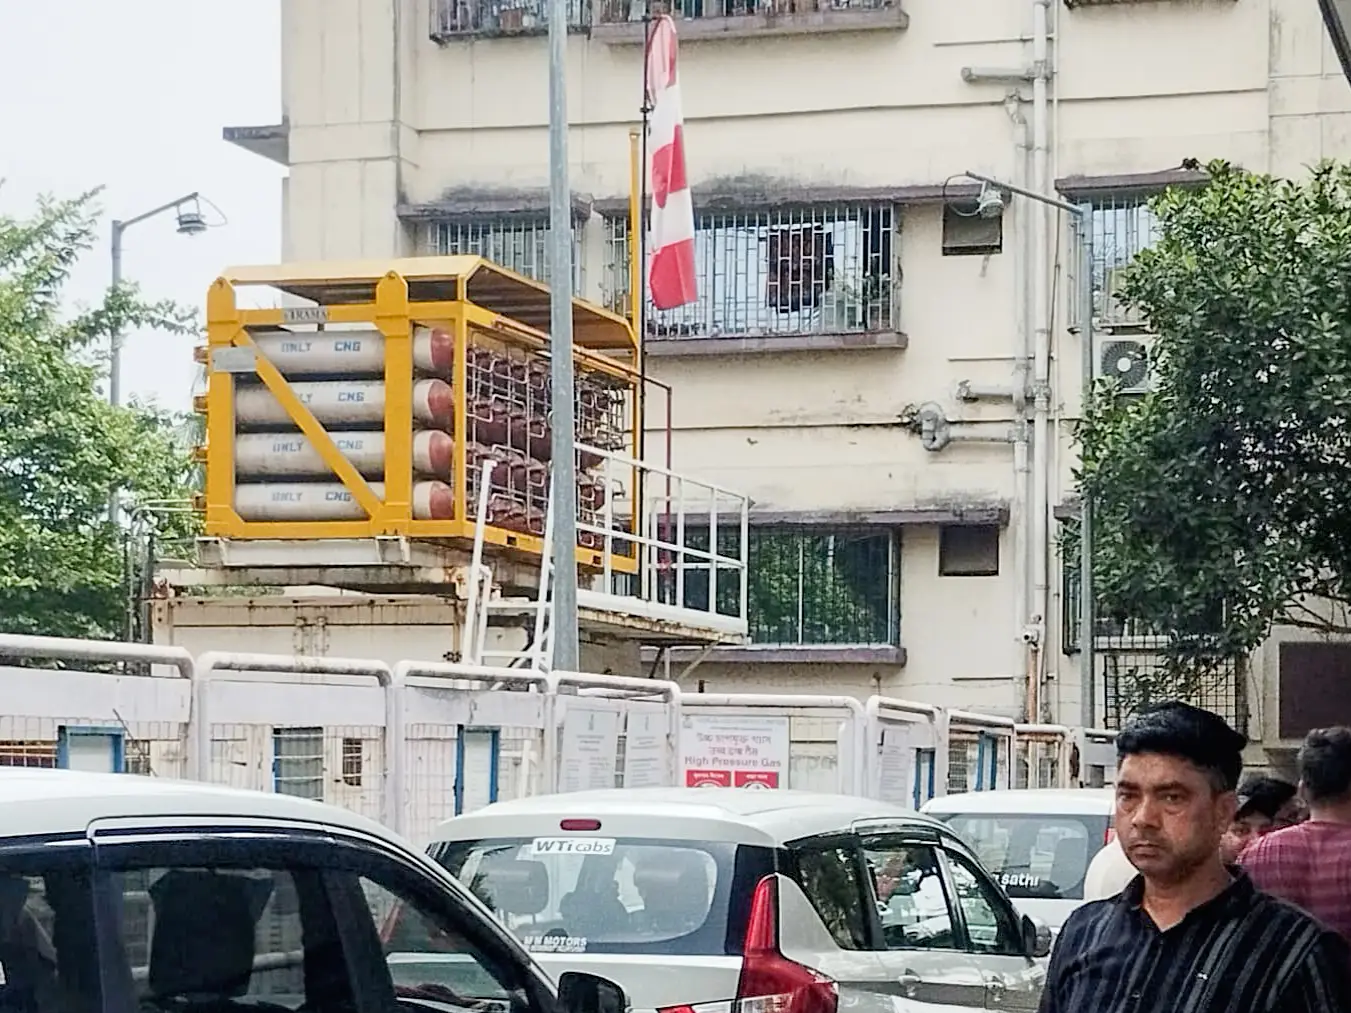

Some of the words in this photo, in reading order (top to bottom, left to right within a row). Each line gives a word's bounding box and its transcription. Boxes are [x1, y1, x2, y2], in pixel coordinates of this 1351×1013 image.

[334, 341, 361, 351] CNG
[338, 391, 365, 402] CNG
[337, 440, 363, 450] CNG
[325, 491, 352, 501] CNG
[685, 756, 708, 767] High
[712, 757, 758, 767] Pressure
[761, 758, 781, 767] Gas
[1001, 873, 1039, 888] sathi
[543, 935, 587, 947] MOTORS
